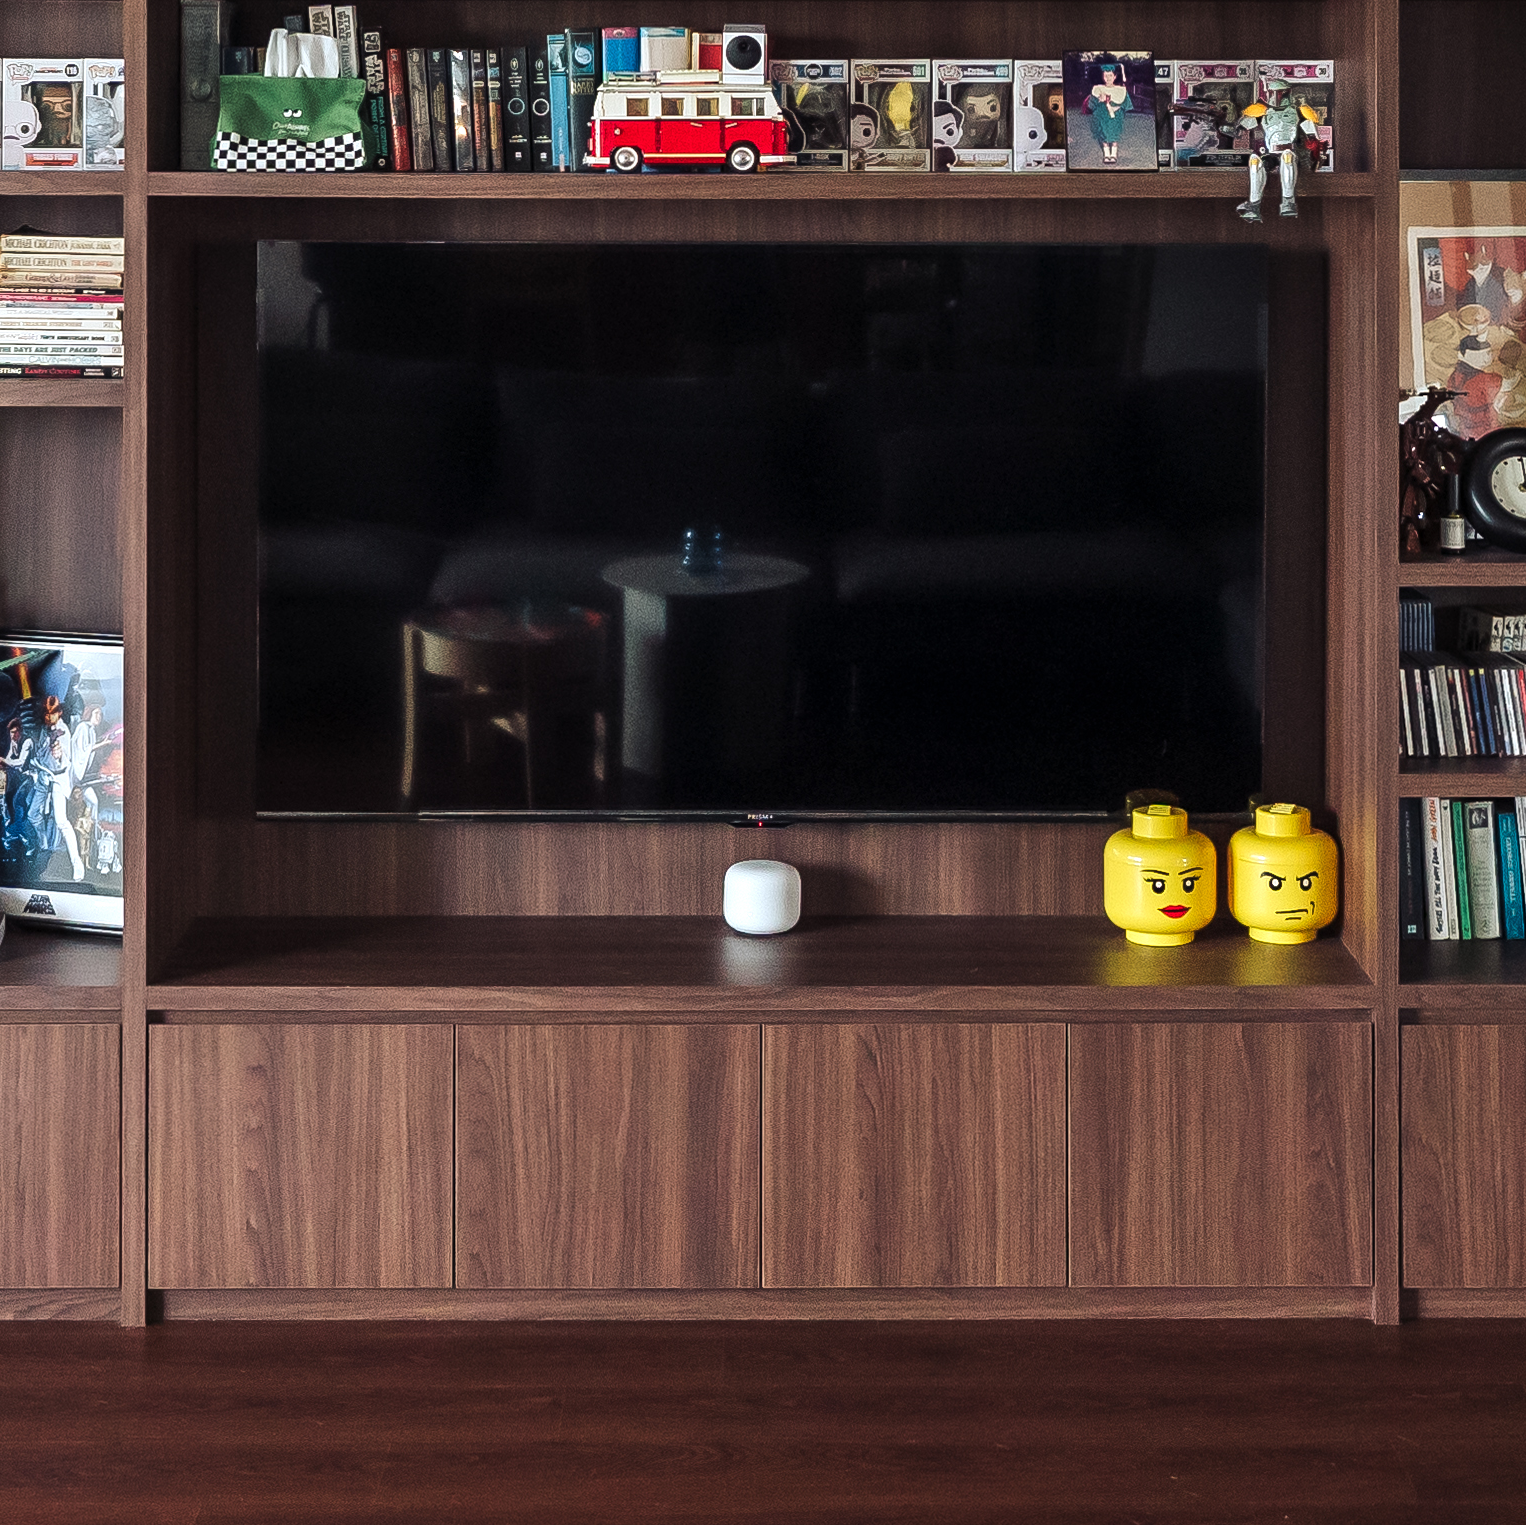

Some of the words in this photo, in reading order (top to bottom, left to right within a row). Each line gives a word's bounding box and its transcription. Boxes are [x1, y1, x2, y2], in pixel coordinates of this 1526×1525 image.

[365, 55, 377, 93] WARS
[375, 57, 385, 93] STAR
[1158, 67, 1169, 76] 47
[30, 894, 51, 903] STAR
[23, 902, 57, 915] WARS
